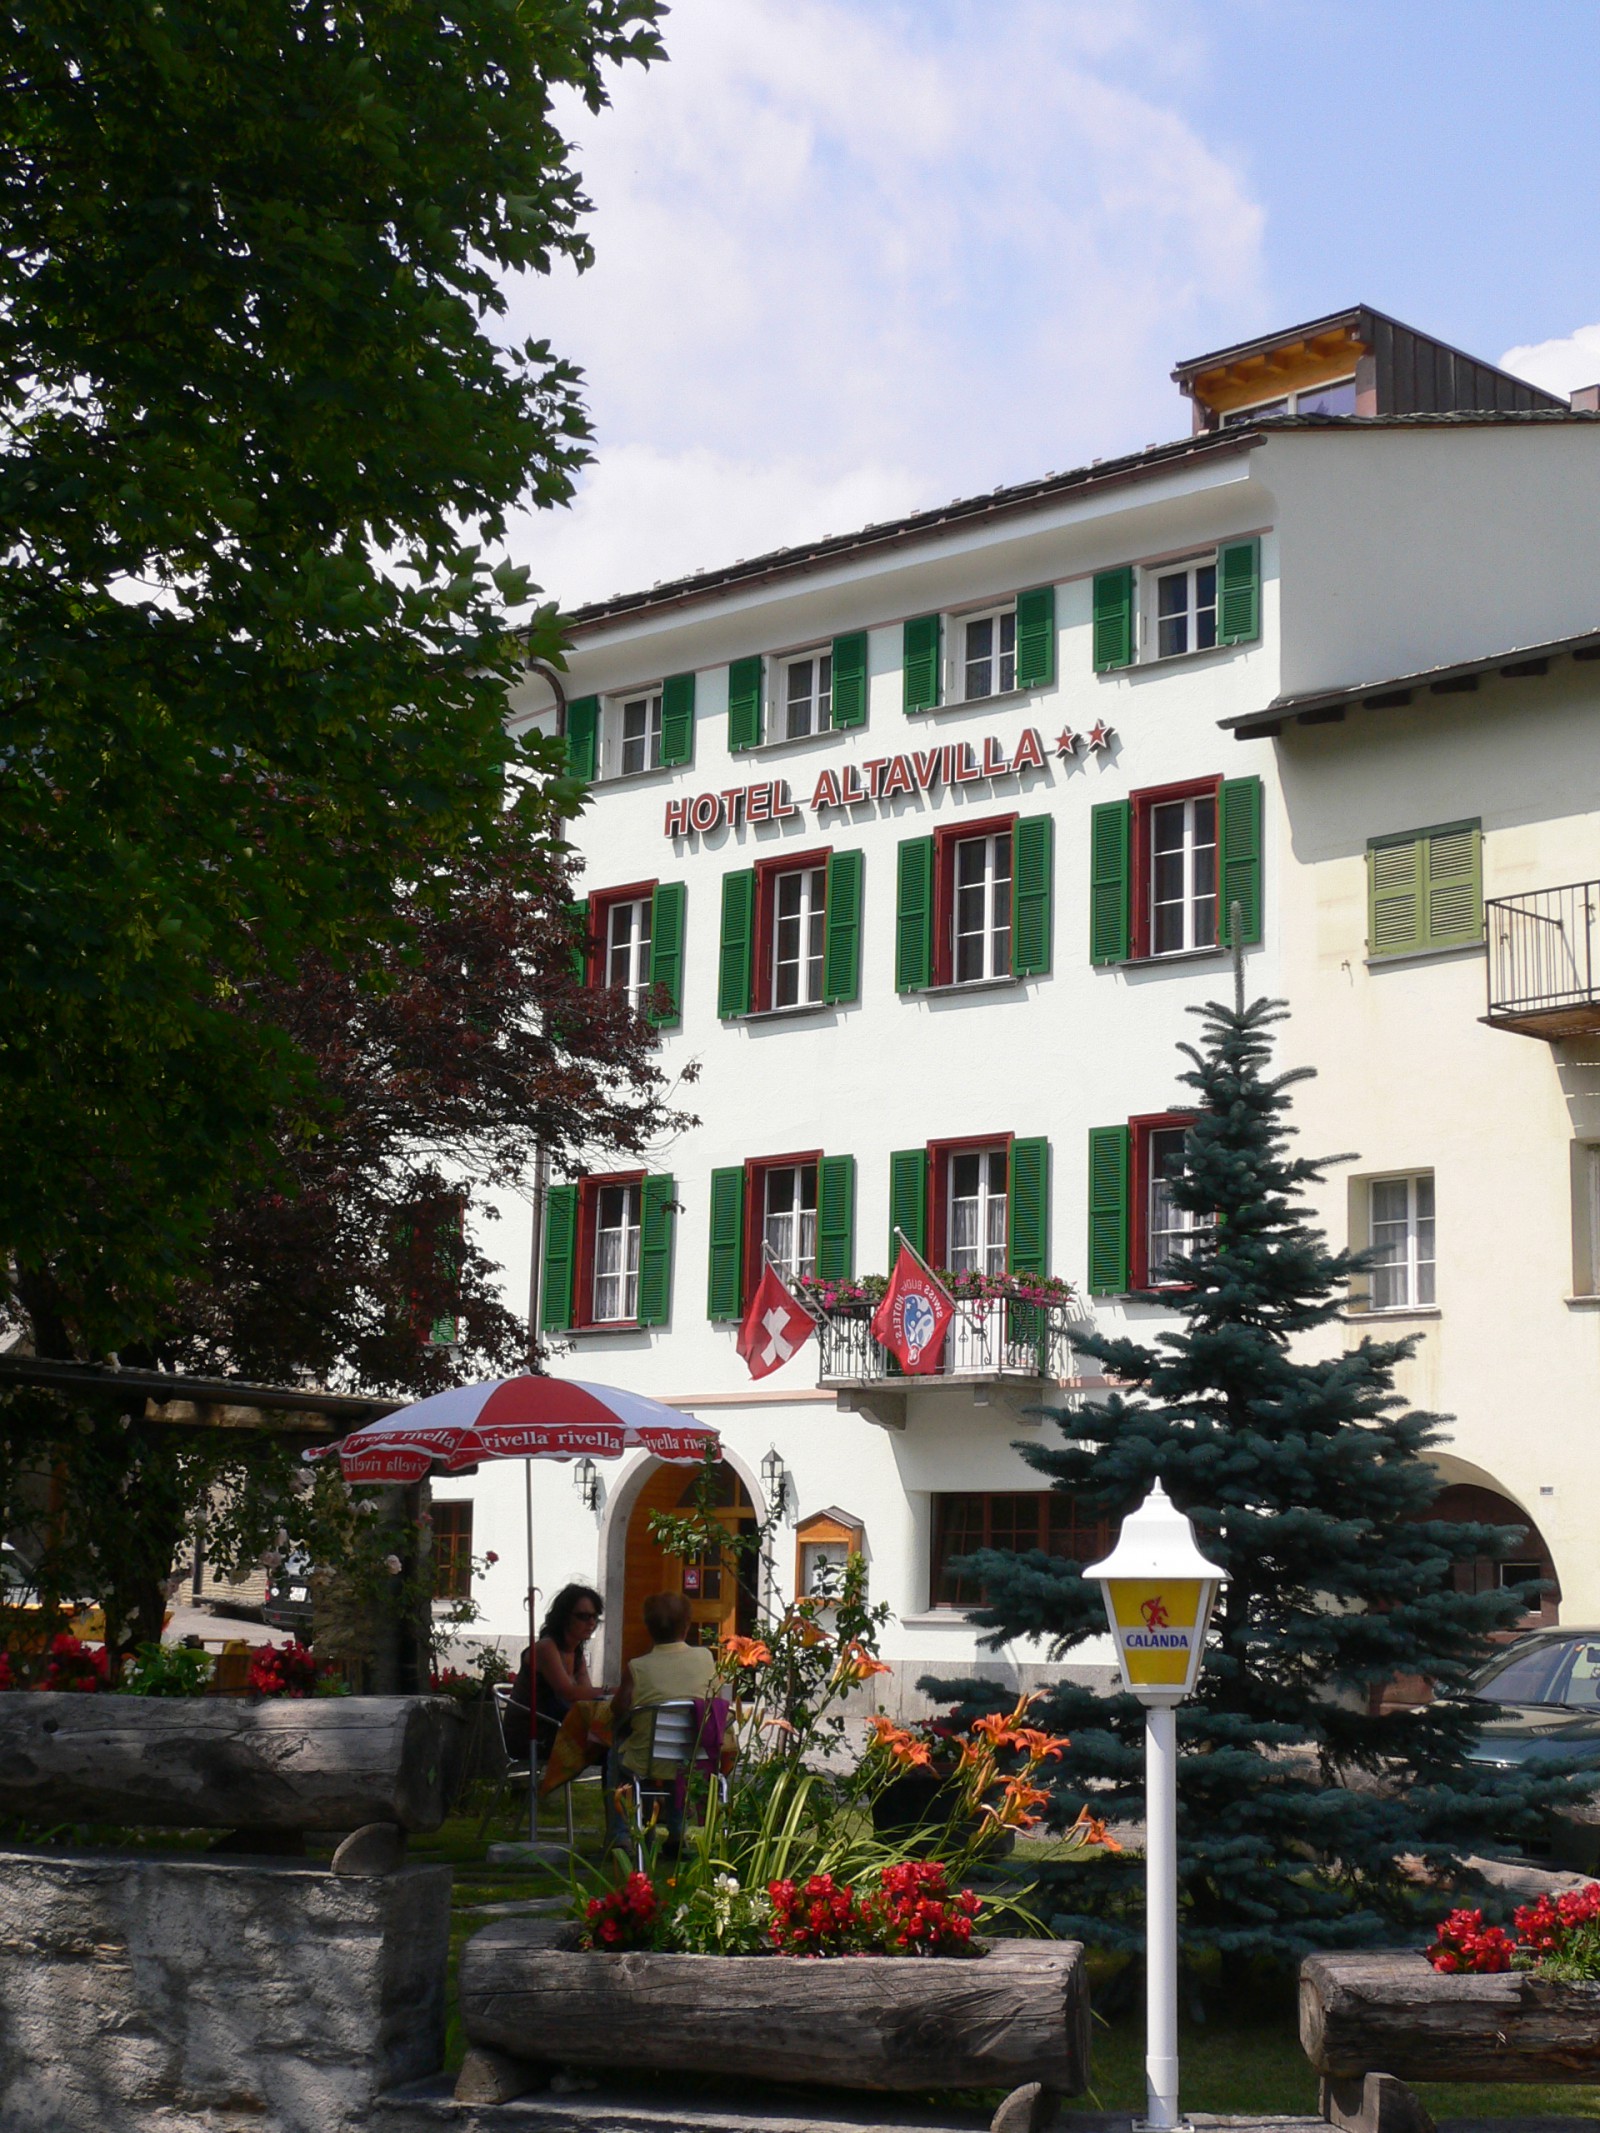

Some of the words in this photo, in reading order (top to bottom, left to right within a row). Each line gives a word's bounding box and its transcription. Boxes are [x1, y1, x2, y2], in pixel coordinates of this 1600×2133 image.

[664, 779, 796, 839] HOTEL
[810, 727, 1046, 811] ALTAVILLA
[401, 1430, 456, 1449] rivella
[483, 1431, 549, 1448] rivella
[557, 1430, 621, 1449] rivella
[645, 1433, 680, 1450] ivella
[1126, 1634, 1188, 1648] CALANDA
